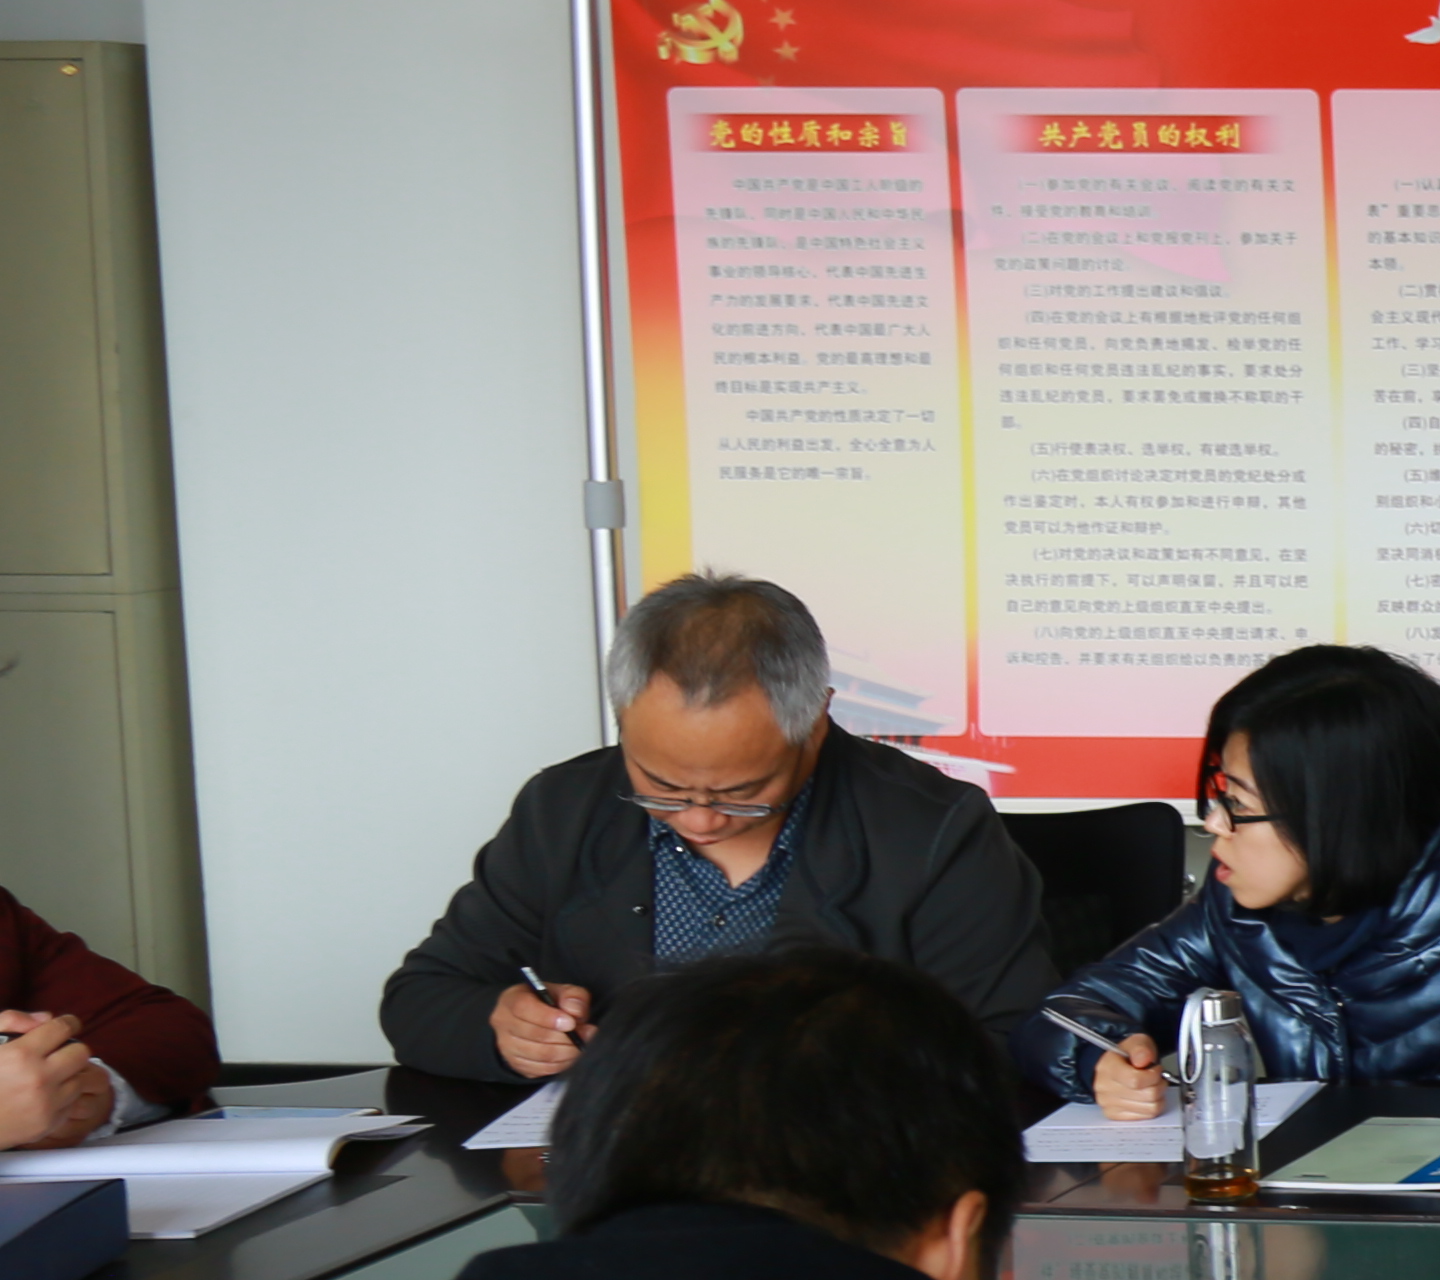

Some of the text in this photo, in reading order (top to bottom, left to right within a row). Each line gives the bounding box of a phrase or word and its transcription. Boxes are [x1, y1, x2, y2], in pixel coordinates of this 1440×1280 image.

[709, 120, 907, 149] 党的性质和宗旨
[1038, 121, 1242, 150] 共产党员的权利
